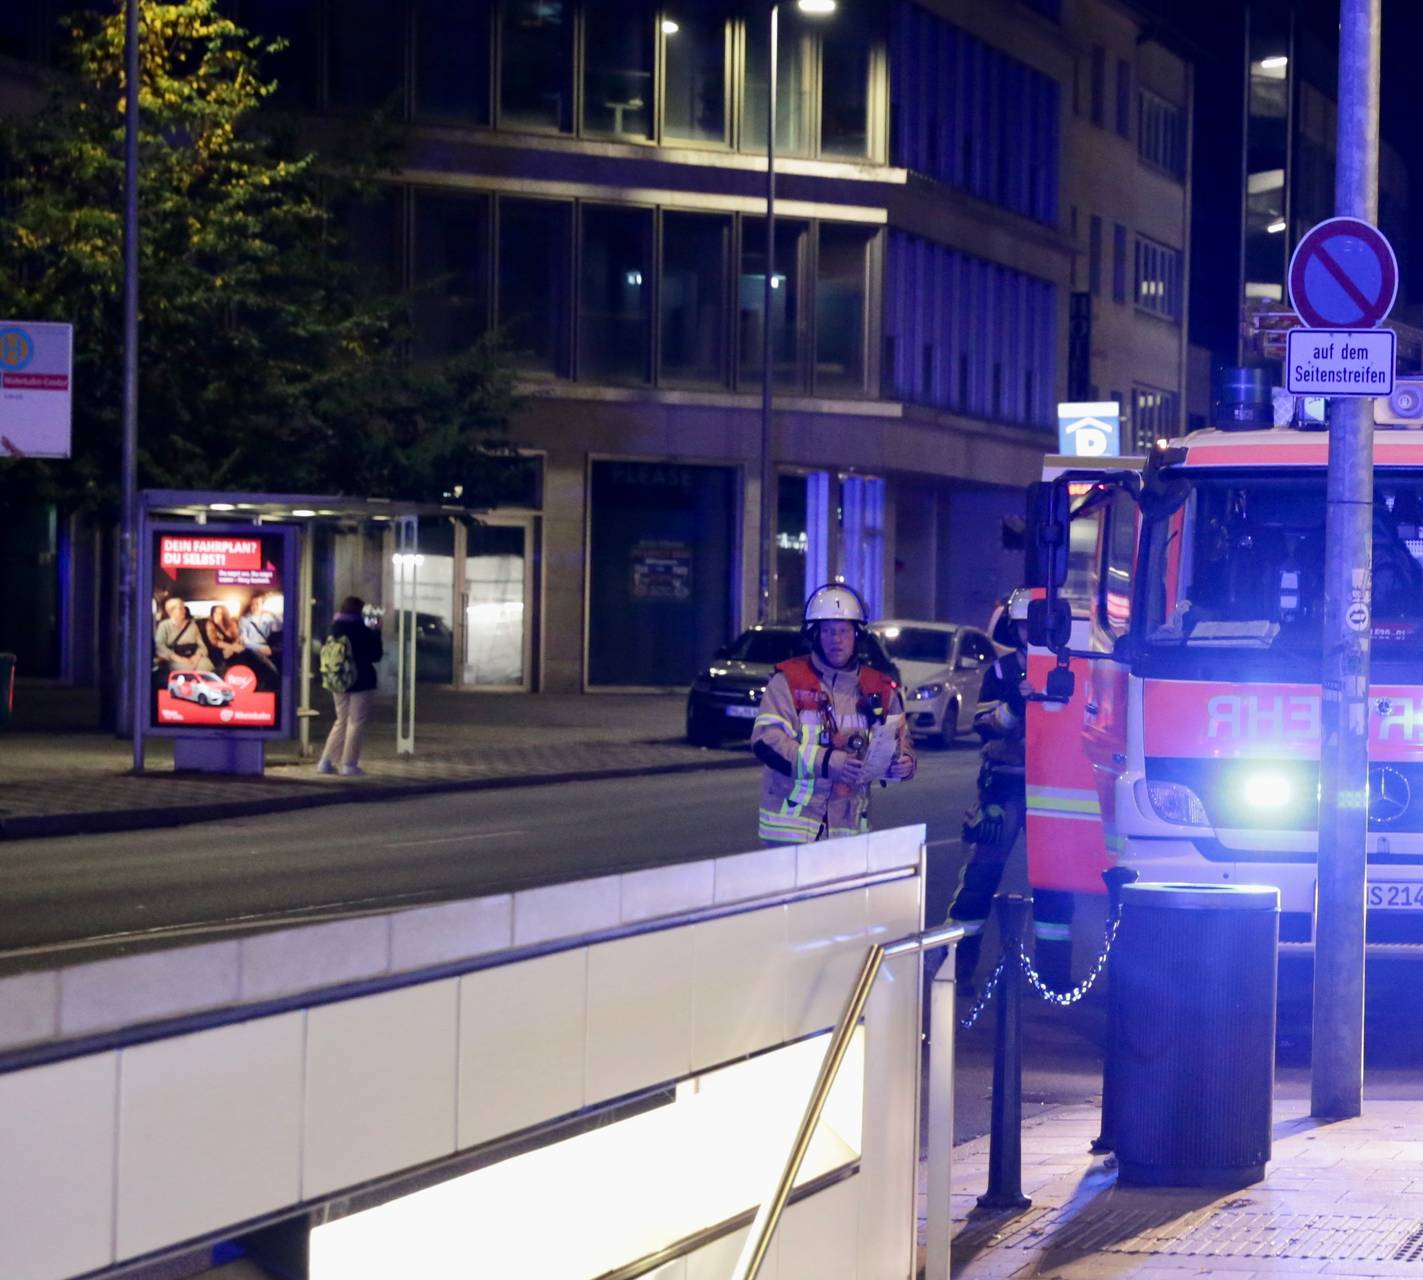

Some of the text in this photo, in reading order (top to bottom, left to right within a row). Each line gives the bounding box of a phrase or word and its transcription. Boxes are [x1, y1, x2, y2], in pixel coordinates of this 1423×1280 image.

[1313, 344, 1368, 360] auf dem
[1295, 365, 1386, 384] Seitenstreifen
[164, 540, 257, 554] DEIN FAHRPLAN?
[163, 553, 181, 565] DU
[1366, 886, 1383, 906] S
